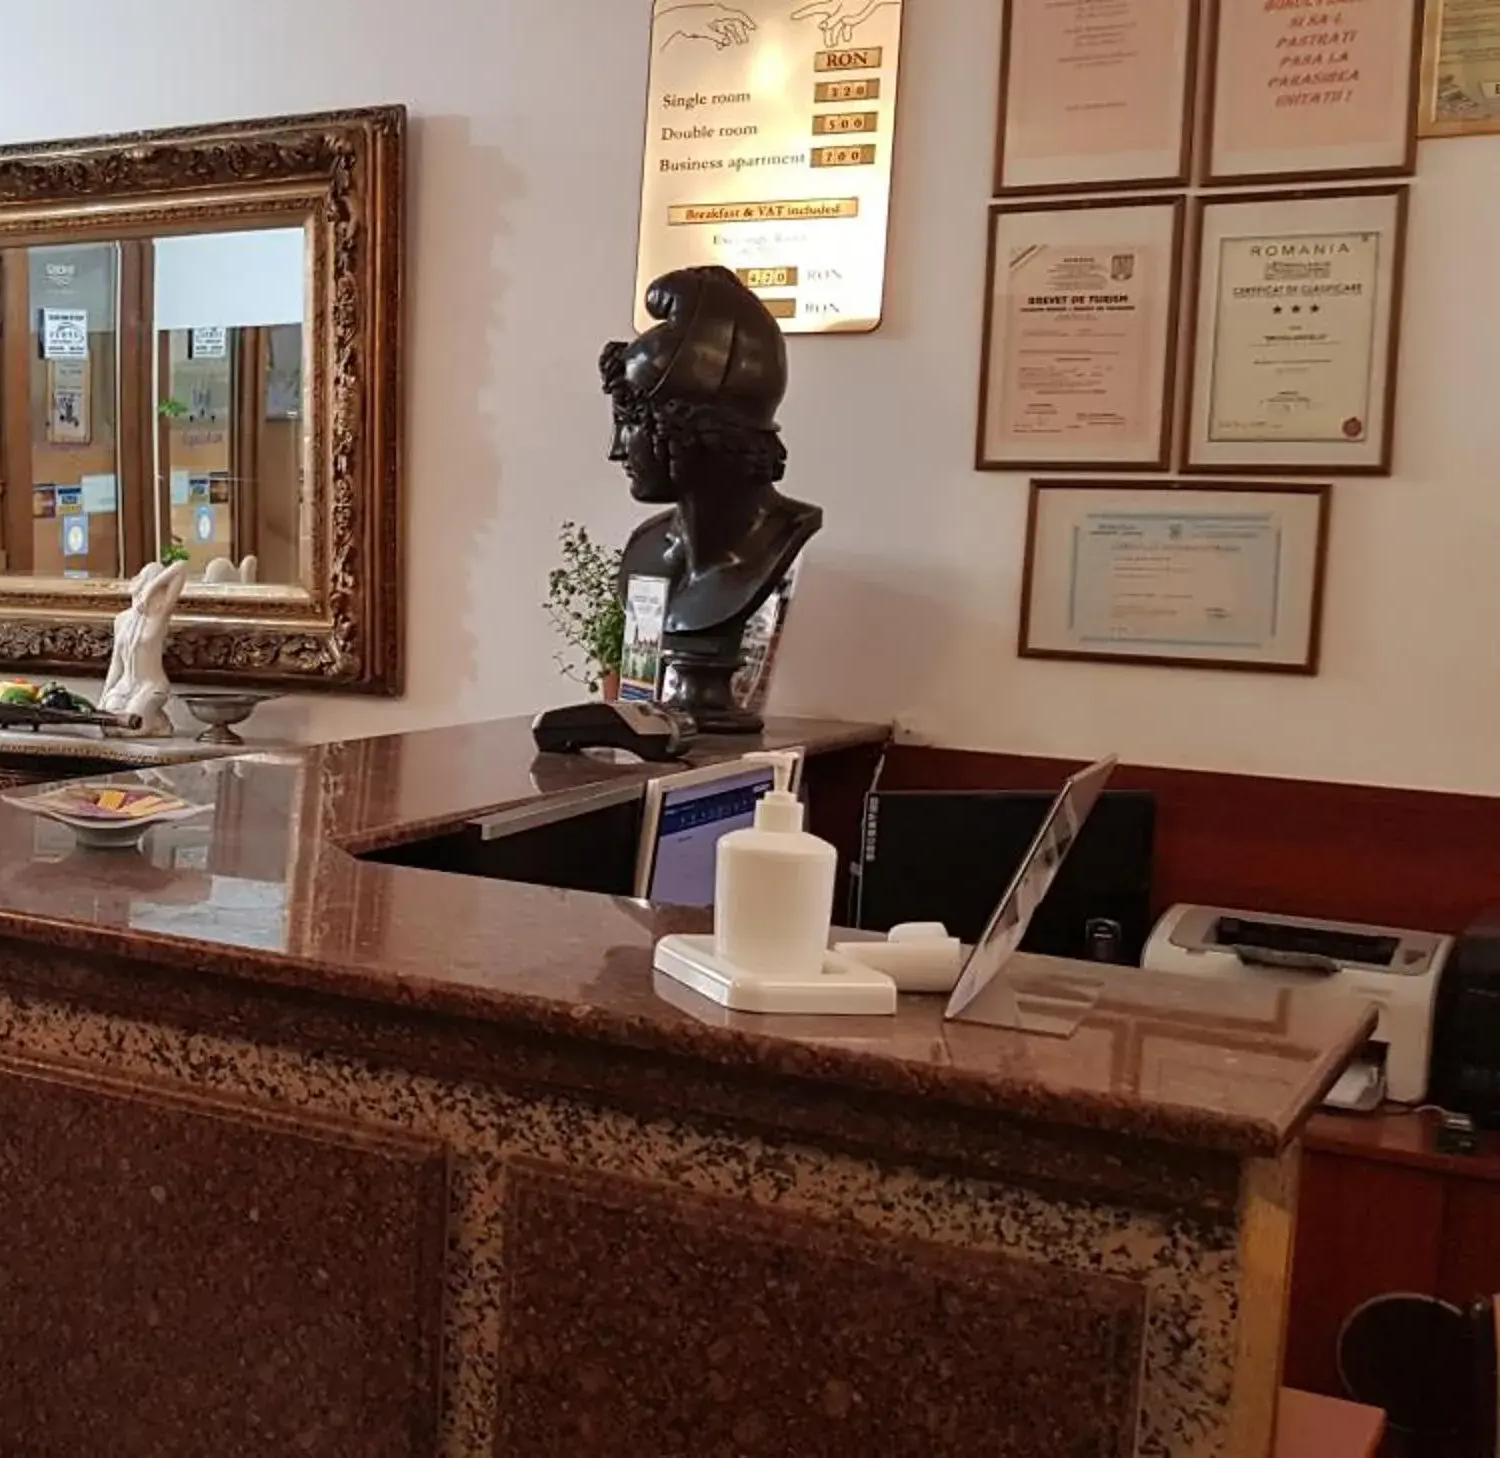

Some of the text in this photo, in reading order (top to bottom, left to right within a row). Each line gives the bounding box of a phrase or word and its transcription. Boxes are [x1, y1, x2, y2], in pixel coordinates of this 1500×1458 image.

[826, 52, 868, 67] RON
[662, 92, 708, 110] Single
[711, 92, 751, 105] room
[661, 125, 715, 141] Double
[719, 125, 758, 138] room
[659, 156, 724, 173] Business
[728, 153, 806, 172] apartment
[685, 203, 841, 221] Breakfast & VAT included
[1250, 243, 1351, 257] ROMANIA
